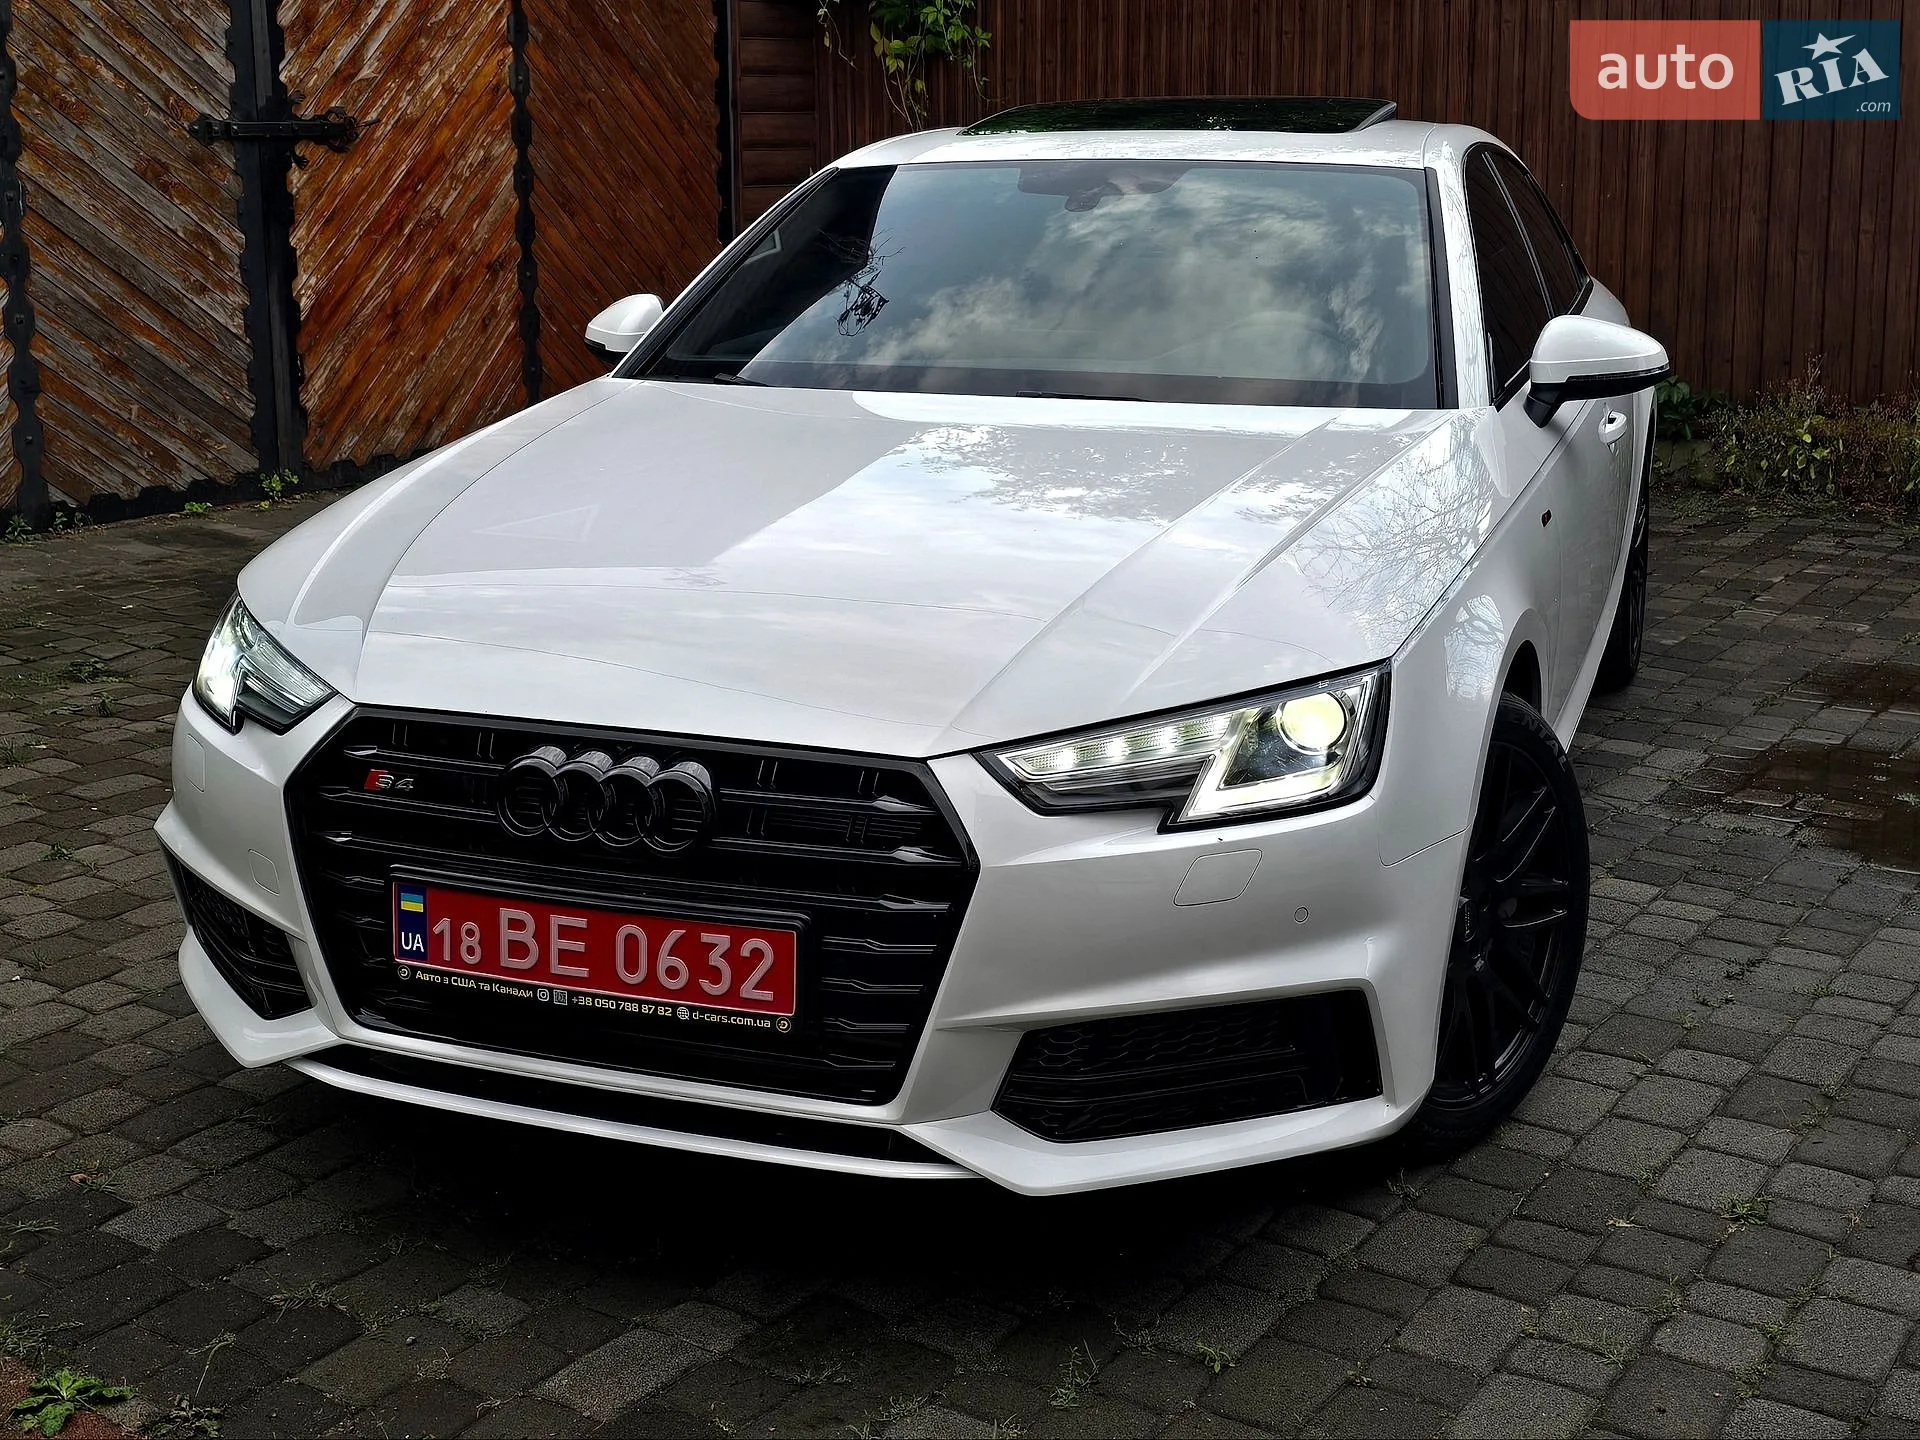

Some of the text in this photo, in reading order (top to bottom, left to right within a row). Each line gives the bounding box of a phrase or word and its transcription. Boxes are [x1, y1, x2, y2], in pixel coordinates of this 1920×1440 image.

[374, 774, 415, 792] S4
[401, 931, 425, 953] UA
[432, 907, 775, 1002] 18 BE 0632
[415, 970, 441, 983] Авто
[451, 976, 477, 989] США
[478, 981, 491, 991] та
[492, 983, 534, 999] Канади
[572, 995, 593, 1006] +38
[594, 998, 616, 1010] 050
[641, 1004, 656, 1015] 87
[657, 1006, 673, 1017] 82
[692, 1010, 771, 1028] d-cars.com.ua
